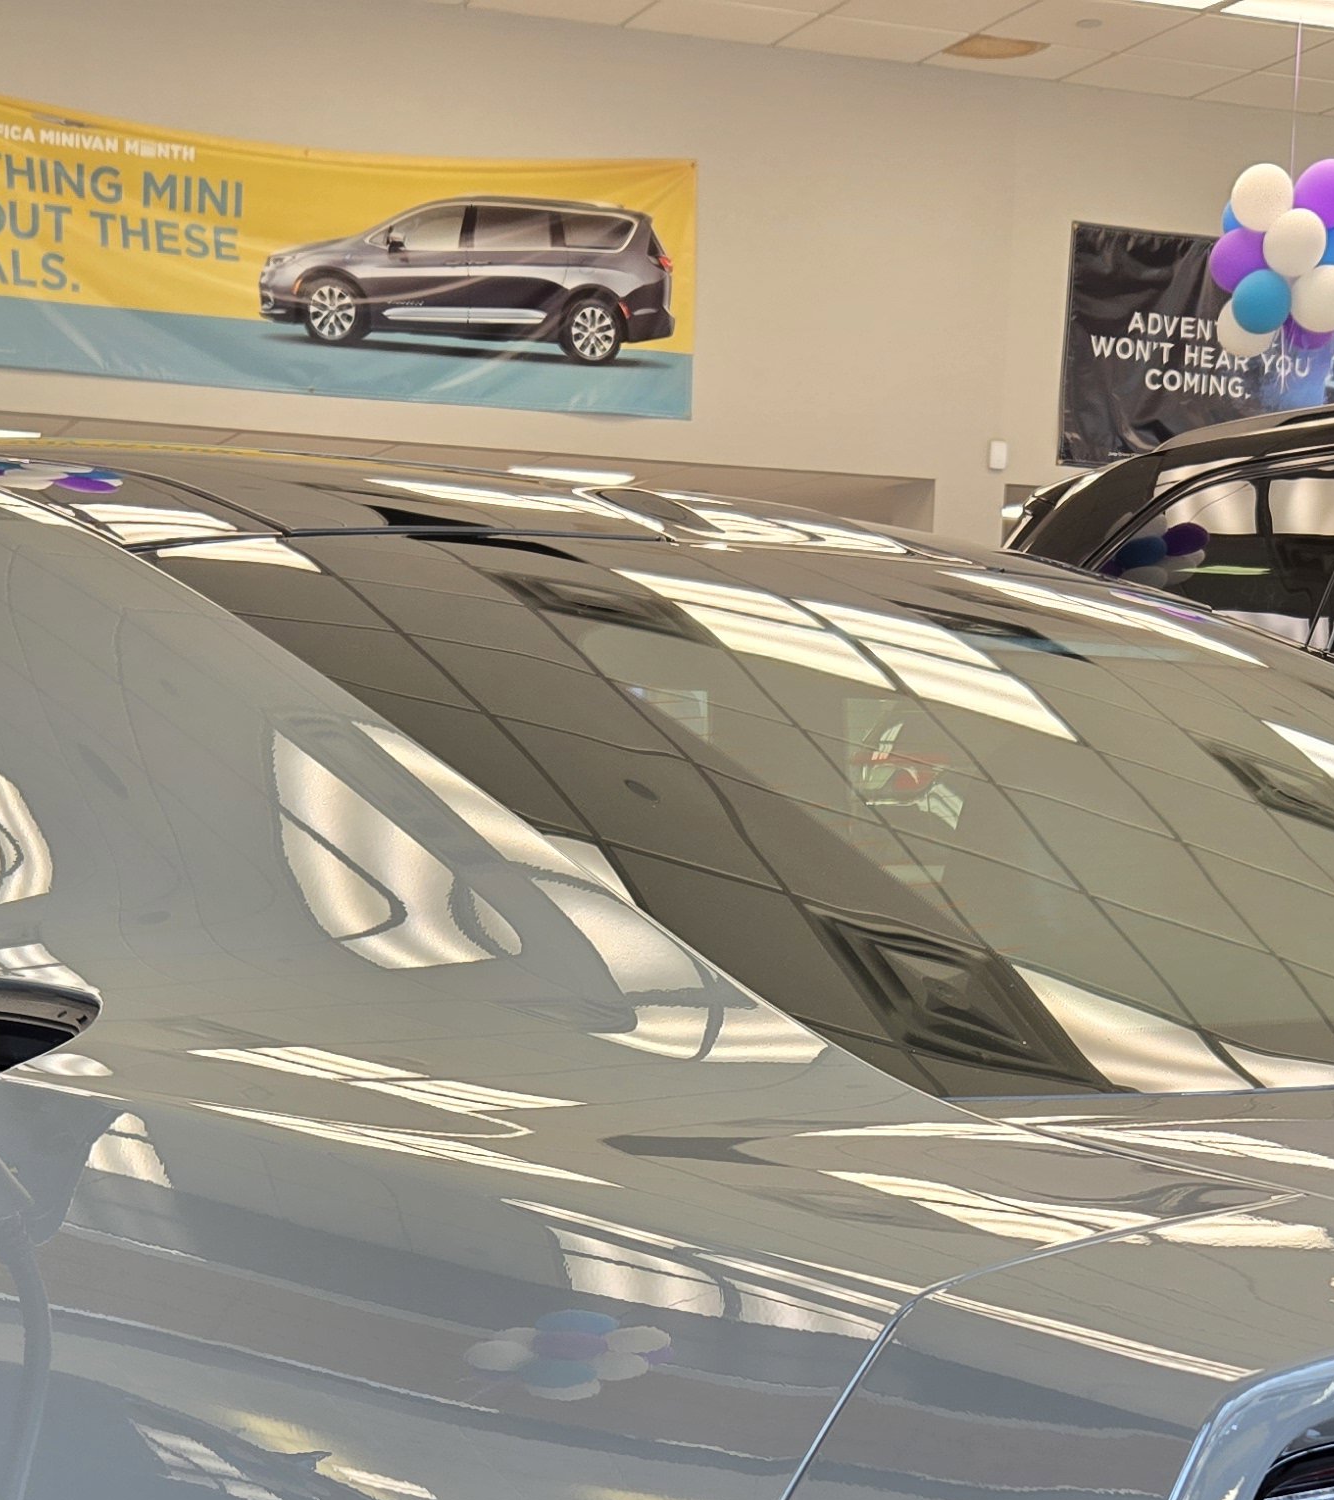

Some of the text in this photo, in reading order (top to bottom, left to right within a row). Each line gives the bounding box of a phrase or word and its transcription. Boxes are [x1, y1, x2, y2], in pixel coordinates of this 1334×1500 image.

[39, 128, 119, 153] MINIVAN
[142, 170, 243, 219] MINI
[89, 209, 241, 262] THESE
[1127, 311, 1218, 341] ADVEN
[1090, 334, 1310, 378] WON'T HEAR YOU
[1145, 368, 1252, 399] COMING.
